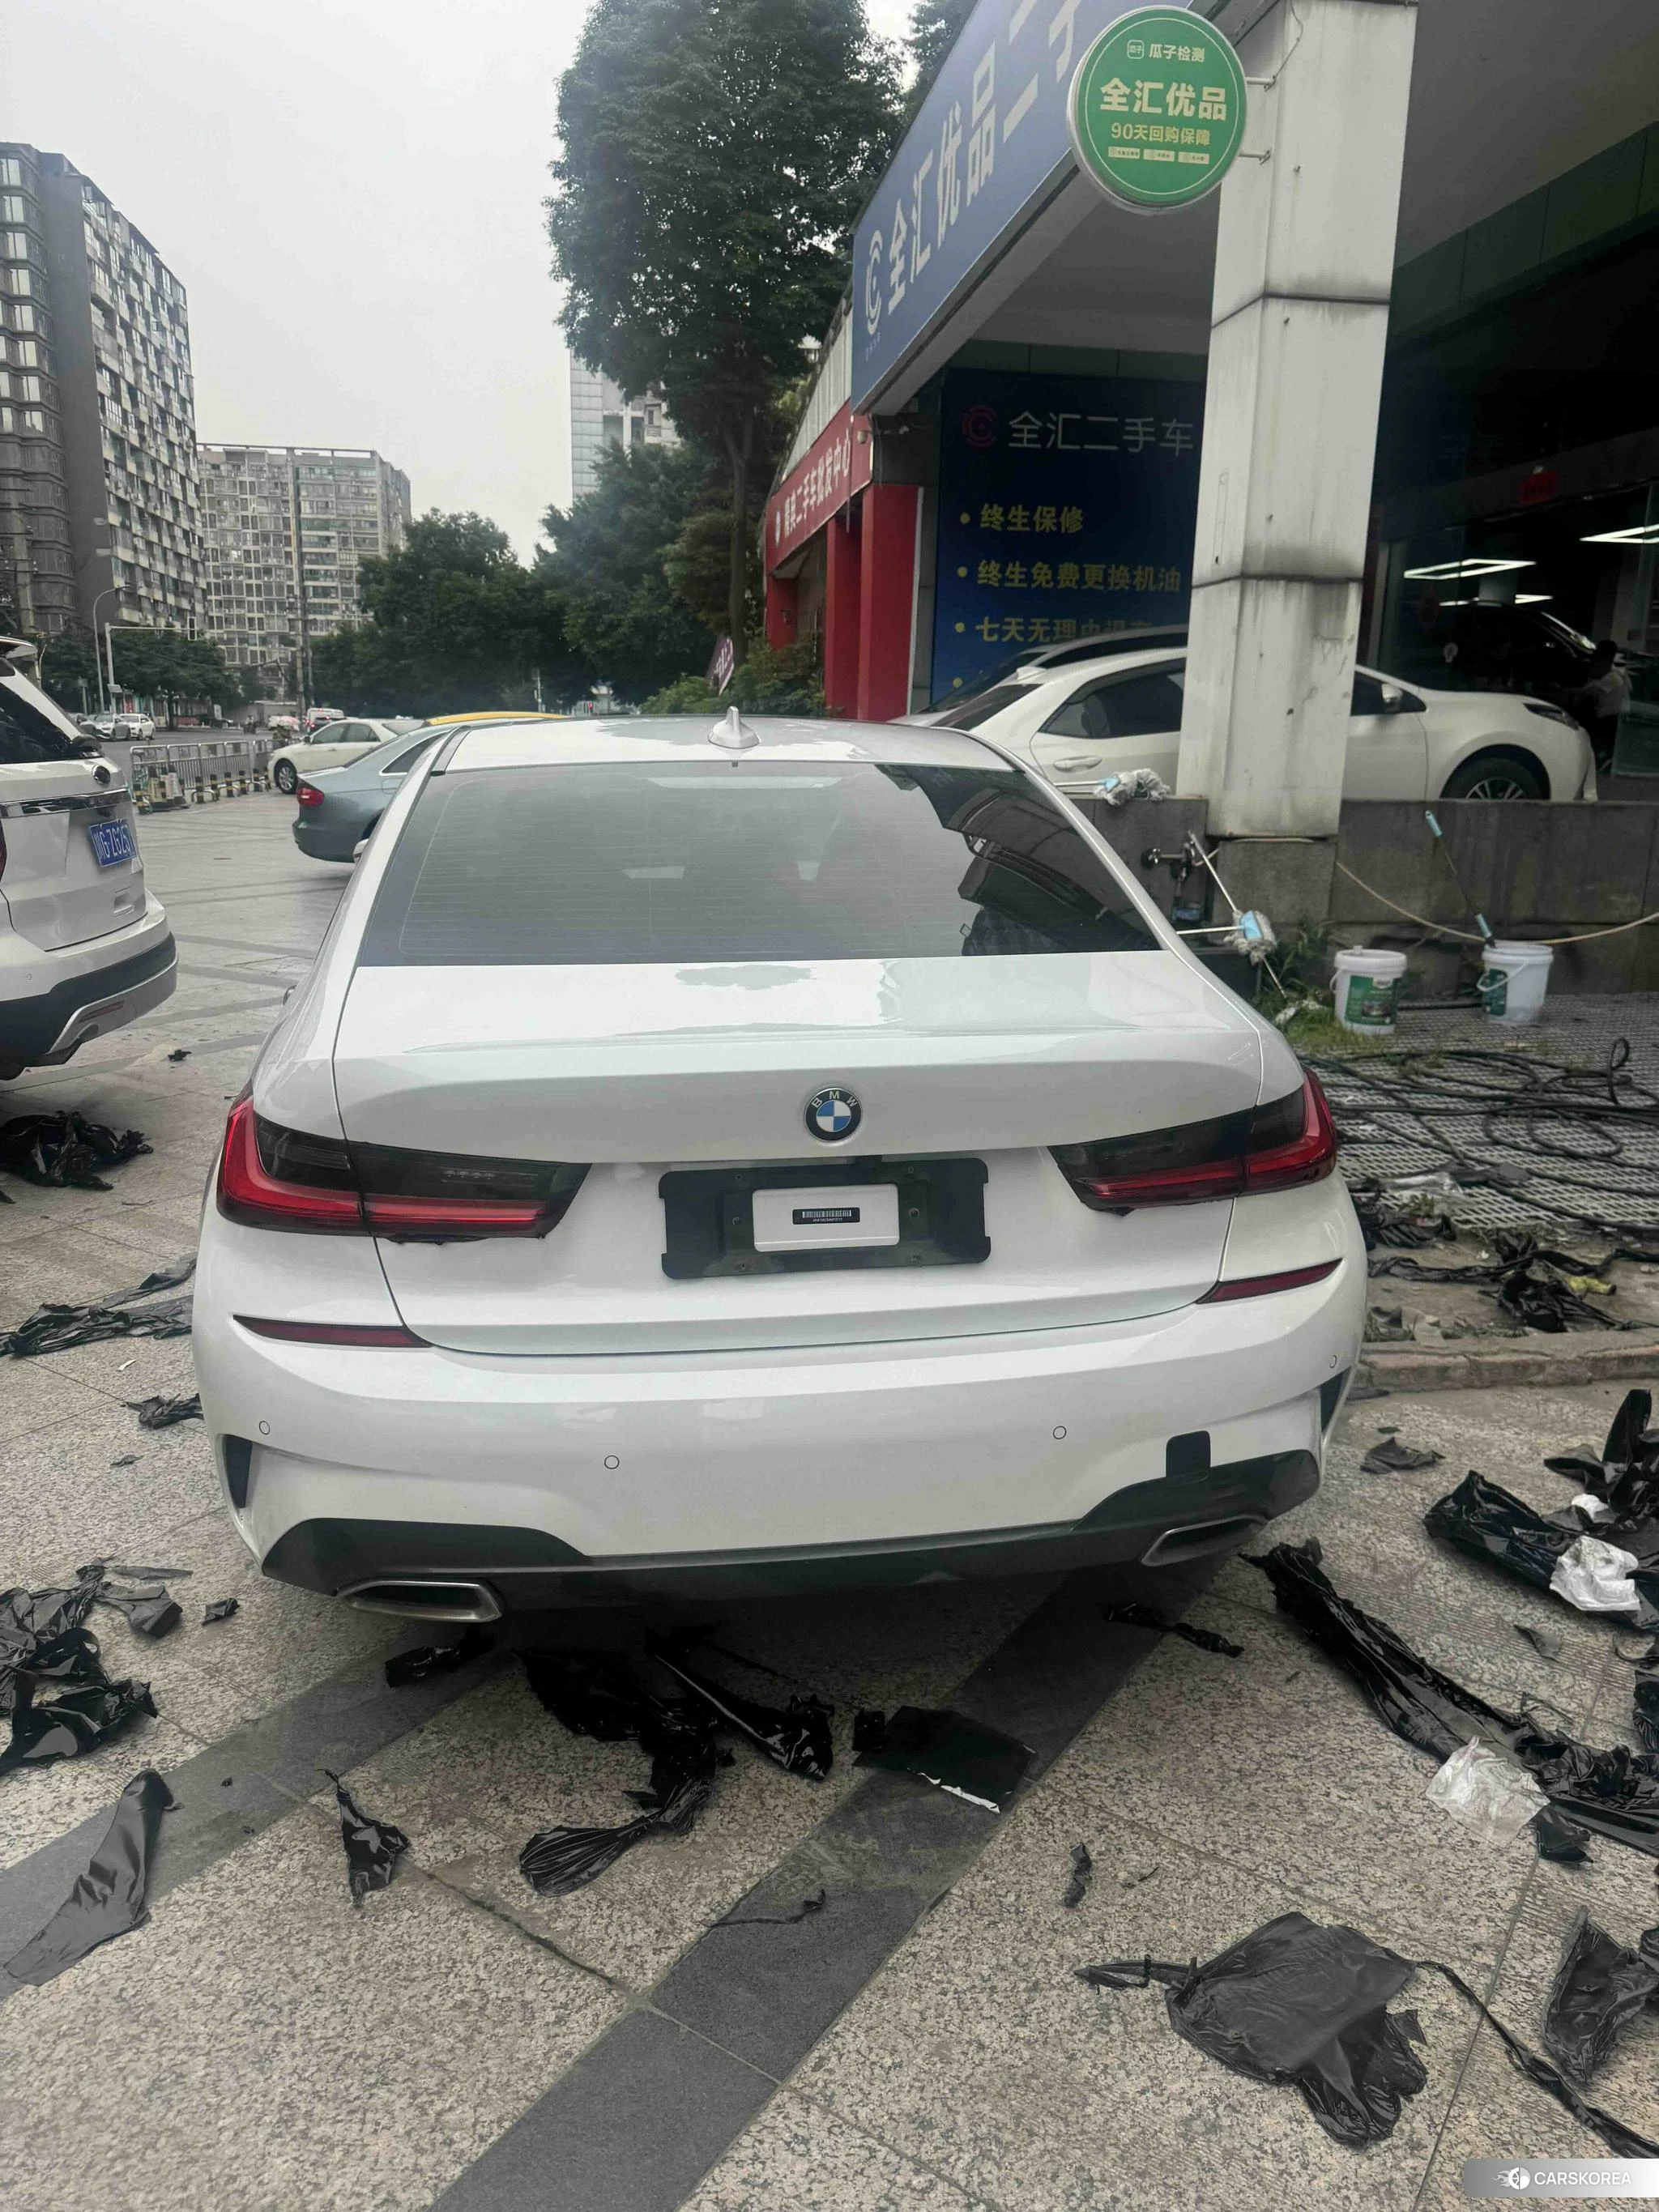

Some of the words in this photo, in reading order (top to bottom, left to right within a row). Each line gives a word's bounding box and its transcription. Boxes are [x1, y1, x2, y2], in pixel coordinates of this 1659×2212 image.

[1149, 43, 1205, 62] 瓜子检测
[1099, 78, 1227, 121] 全汇优品
[1111, 122, 1211, 146] 90天回购保障
[1009, 411, 1194, 457] 全汇二手车
[979, 503, 1084, 534] 终生保修
[977, 560, 1181, 592] 终生免费更换机油
[811, 1091, 858, 1108] BMW
